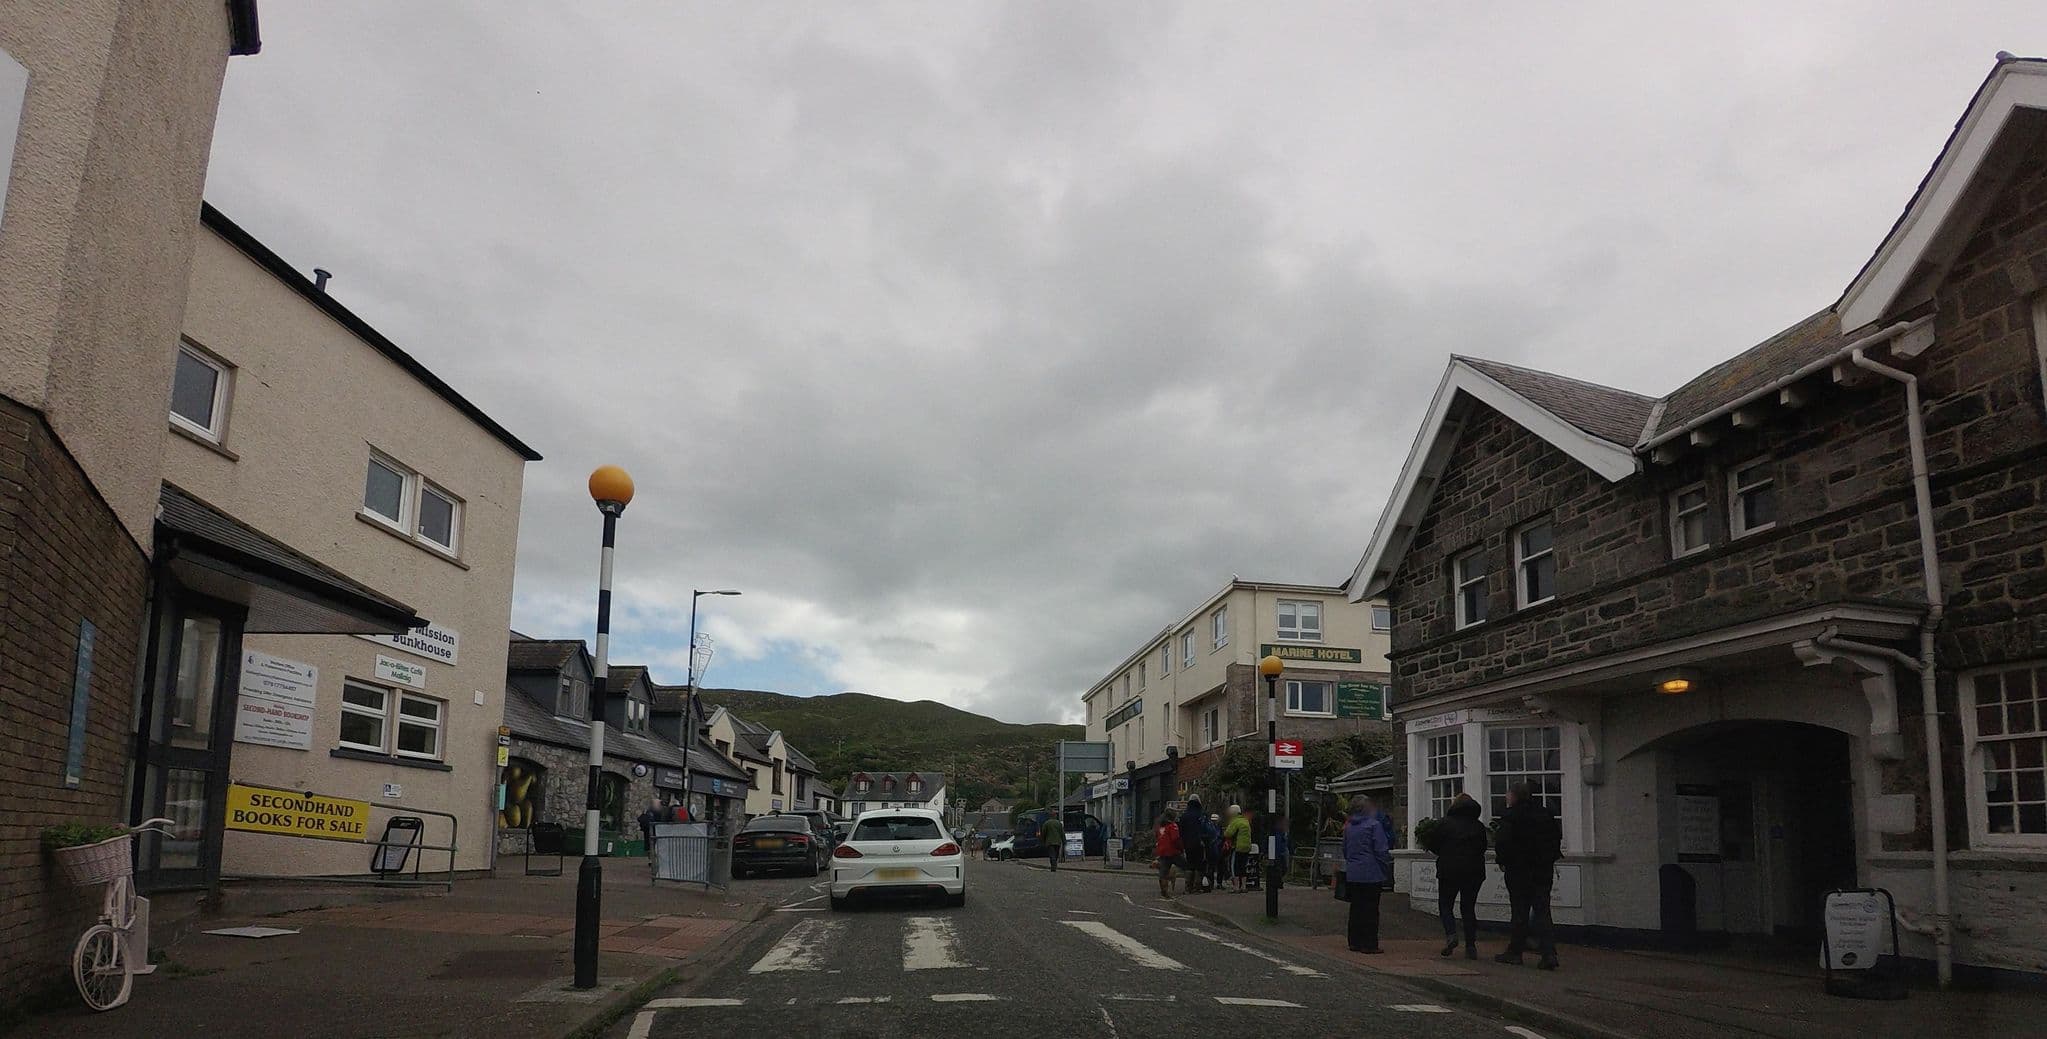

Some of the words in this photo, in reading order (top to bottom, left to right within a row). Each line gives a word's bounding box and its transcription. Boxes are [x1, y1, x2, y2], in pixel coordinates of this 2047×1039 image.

[392, 633, 452, 659] Bunkhouse
[1271, 647, 1314, 658] MARINE
[1317, 649, 1353, 660] HOTEL
[391, 671, 412, 683] Mallaig
[250, 794, 354, 817] SECONDHAND
[232, 809, 292, 827] BOOKS
[296, 816, 325, 831] FOR
[330, 820, 363, 834] SALE
